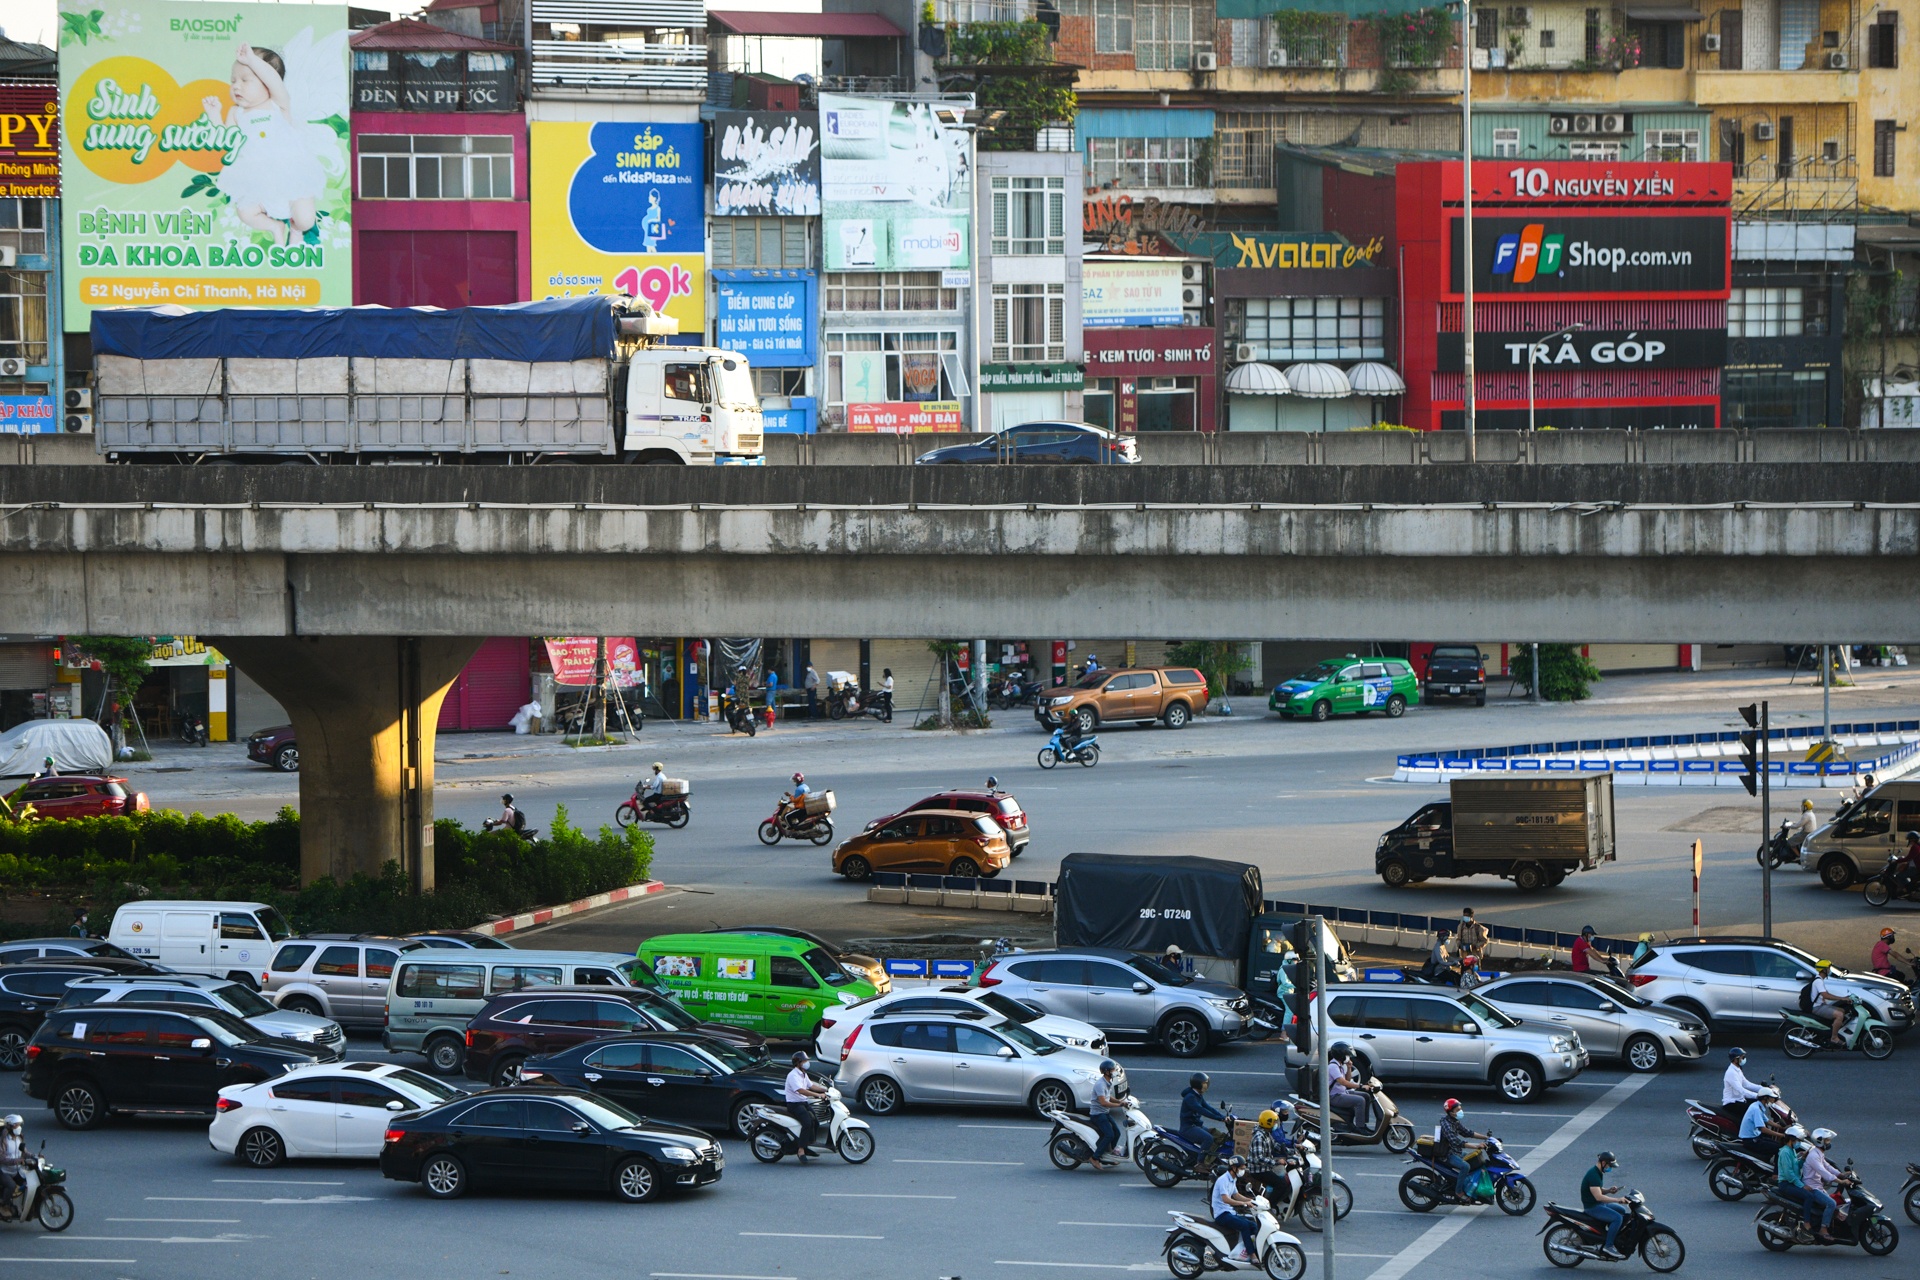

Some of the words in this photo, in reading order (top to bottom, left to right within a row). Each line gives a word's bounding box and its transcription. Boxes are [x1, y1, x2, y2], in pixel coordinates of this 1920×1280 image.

[170, 18, 237, 32] BAOSON
[87, 78, 161, 121] Sinh
[360, 87, 397, 103] ĐÈN
[404, 89, 429, 104] AN
[83, 122, 158, 165] sung
[634, 126, 664, 150] SẮP
[616, 153, 651, 168] SINH
[655, 145, 681, 168] RỒI
[33, 163, 58, 175] Minh
[603, 173, 618, 184] đến
[619, 170, 677, 184] KidsPlaza
[677, 175, 693, 184] thôi
[10, 183, 56, 196] Inverter
[1510, 167, 1550, 196] 10
[1554, 170, 1628, 196] NGUYỄN
[1633, 170, 1674, 196] XIỂN
[78, 207, 147, 240] BỆNH
[153, 208, 212, 241] VIỆN
[79, 245, 118, 267] ĐA
[126, 246, 202, 268] KHOA
[208, 239, 264, 268] BẢO
[270, 244, 323, 268] SƠN
[1230, 231, 1343, 268] Avatar
[1342, 236, 1384, 268] Café
[1569, 241, 1692, 273] Shop.com.vn
[580, 275, 603, 285] SINH
[90, 284, 109, 298] 52
[112, 281, 170, 301] Nguyễn
[174, 283, 200, 298] Chí
[203, 285, 252, 300] Thanh,
[256, 284, 277, 299] Hà
[281, 284, 306, 301] Nội
[1124, 288, 1140, 298] SAO
[1142, 283, 1153, 298] TỬ
[1154, 287, 1162, 297] VI
[728, 292, 750, 310] ĐIỂM
[752, 296, 776, 310] CUNG
[777, 291, 796, 310] CẤP
[721, 315, 736, 332] HẢI
[737, 314, 756, 332] SẢN
[758, 317, 777, 332] TƯƠI
[778, 313, 803, 332] SỐNG
[722, 339, 731, 350] An
[731, 338, 747, 350] Toàn
[753, 337, 765, 350] Giá
[765, 337, 774, 350] Cả
[775, 336, 787, 350] Tốt
[787, 336, 803, 350] Nhất
[1100, 350, 1125, 362] KEM
[1127, 348, 1155, 362] TƯƠI
[1164, 349, 1192, 361] SINH
[1195, 343, 1212, 361] TỐ
[1504, 333, 1581, 365] TRẢ
[1590, 332, 1667, 363] GÓP
[905, 368, 938, 387] YOGA
[17, 397, 53, 418] KHẨU
[853, 413, 871, 424] HÀ
[874, 414, 897, 426] NỘI
[909, 414, 932, 426] NỘI
[935, 411, 957, 423] BÀI
[1140, 908, 1156, 918] 29C
[1164, 909, 1191, 919] 07240
[714, 991, 727, 1001] THEO
[727, 991, 737, 1002] YÊU
